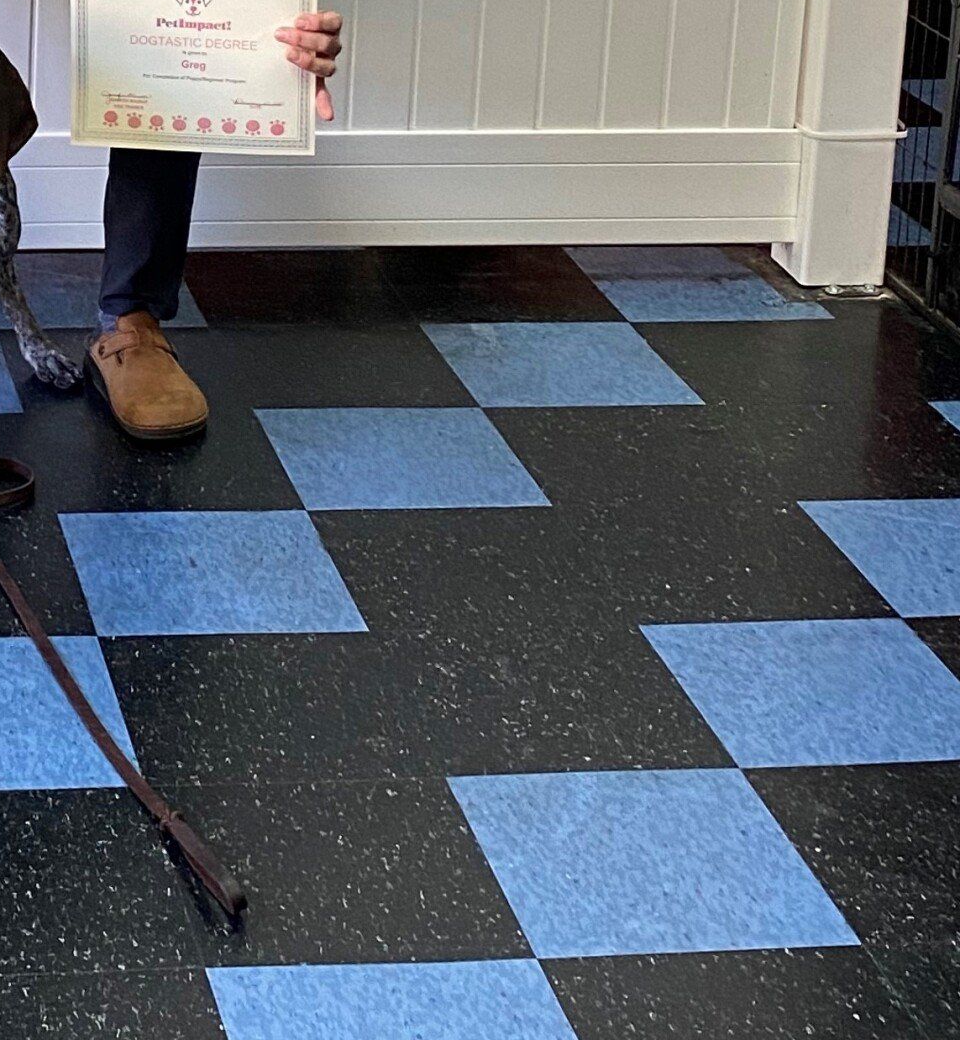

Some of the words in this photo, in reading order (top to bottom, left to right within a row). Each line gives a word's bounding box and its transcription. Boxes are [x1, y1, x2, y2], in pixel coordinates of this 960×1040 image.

[129, 34, 202, 48] DOGTASTIC
[205, 39, 258, 51] DEGREE
[181, 59, 206, 72] Greg
